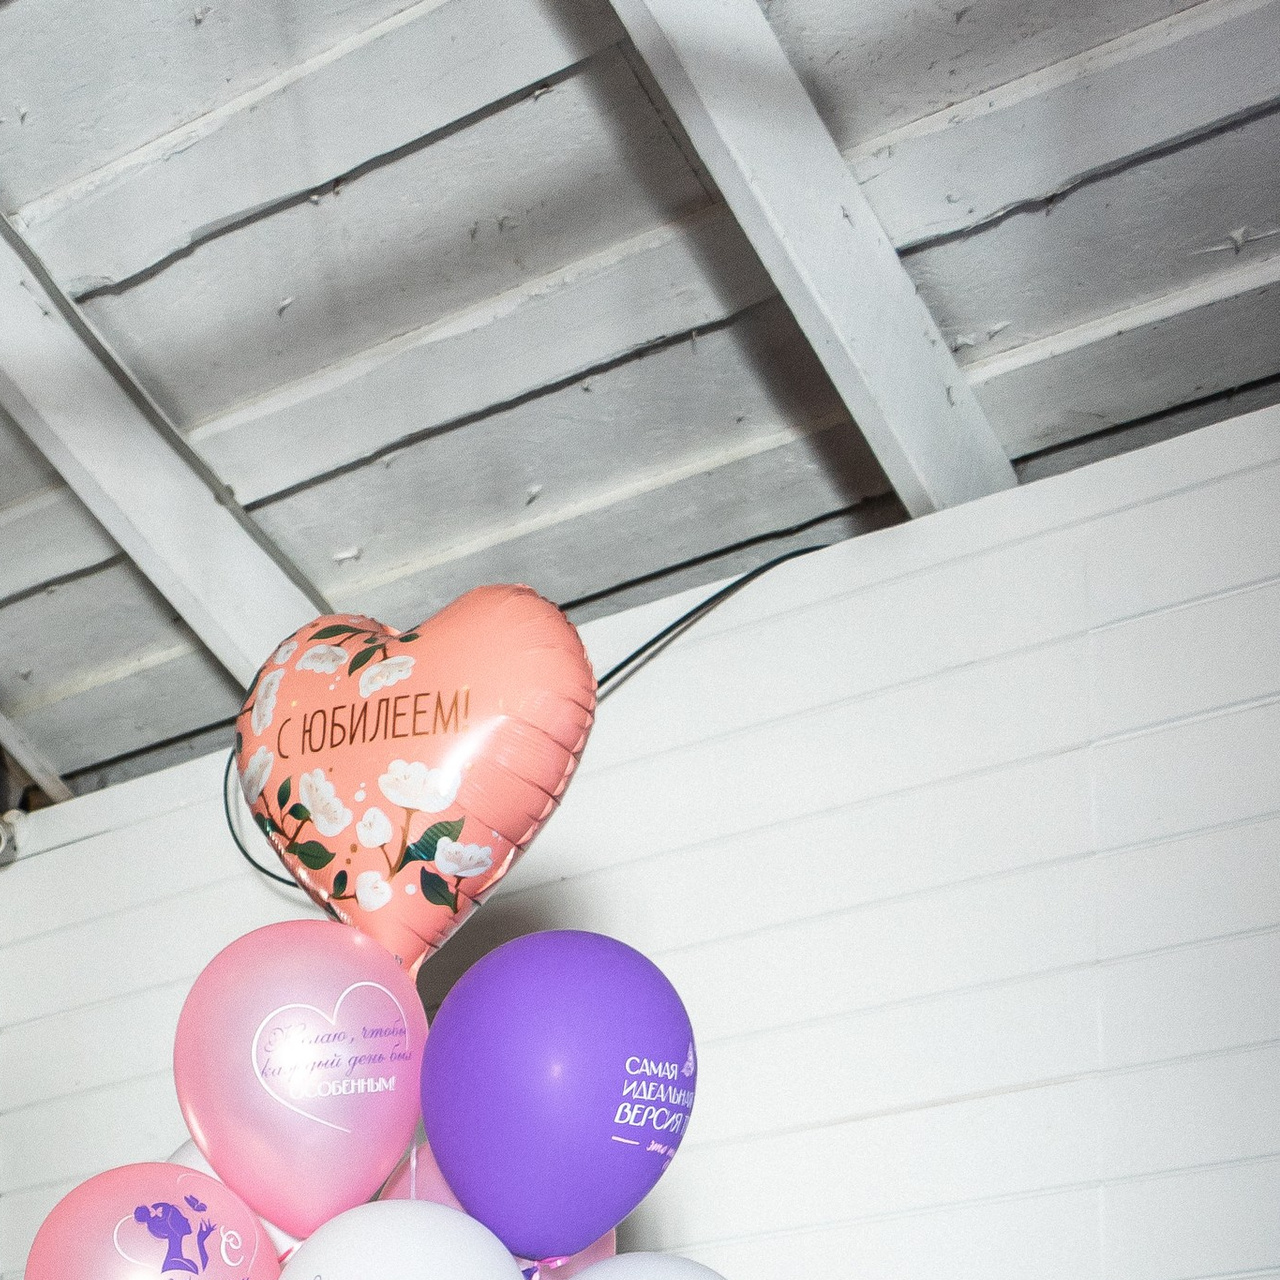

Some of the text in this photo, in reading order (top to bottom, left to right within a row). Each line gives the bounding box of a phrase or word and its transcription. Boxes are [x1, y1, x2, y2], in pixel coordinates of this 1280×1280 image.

[301, 689, 471, 755] ЮБИЛЕЕМ!
[345, 1053, 384, 1077] день
[624, 1056, 678, 1080] САМАЯ
[614, 1102, 682, 1135] ВЕРСИЯ
